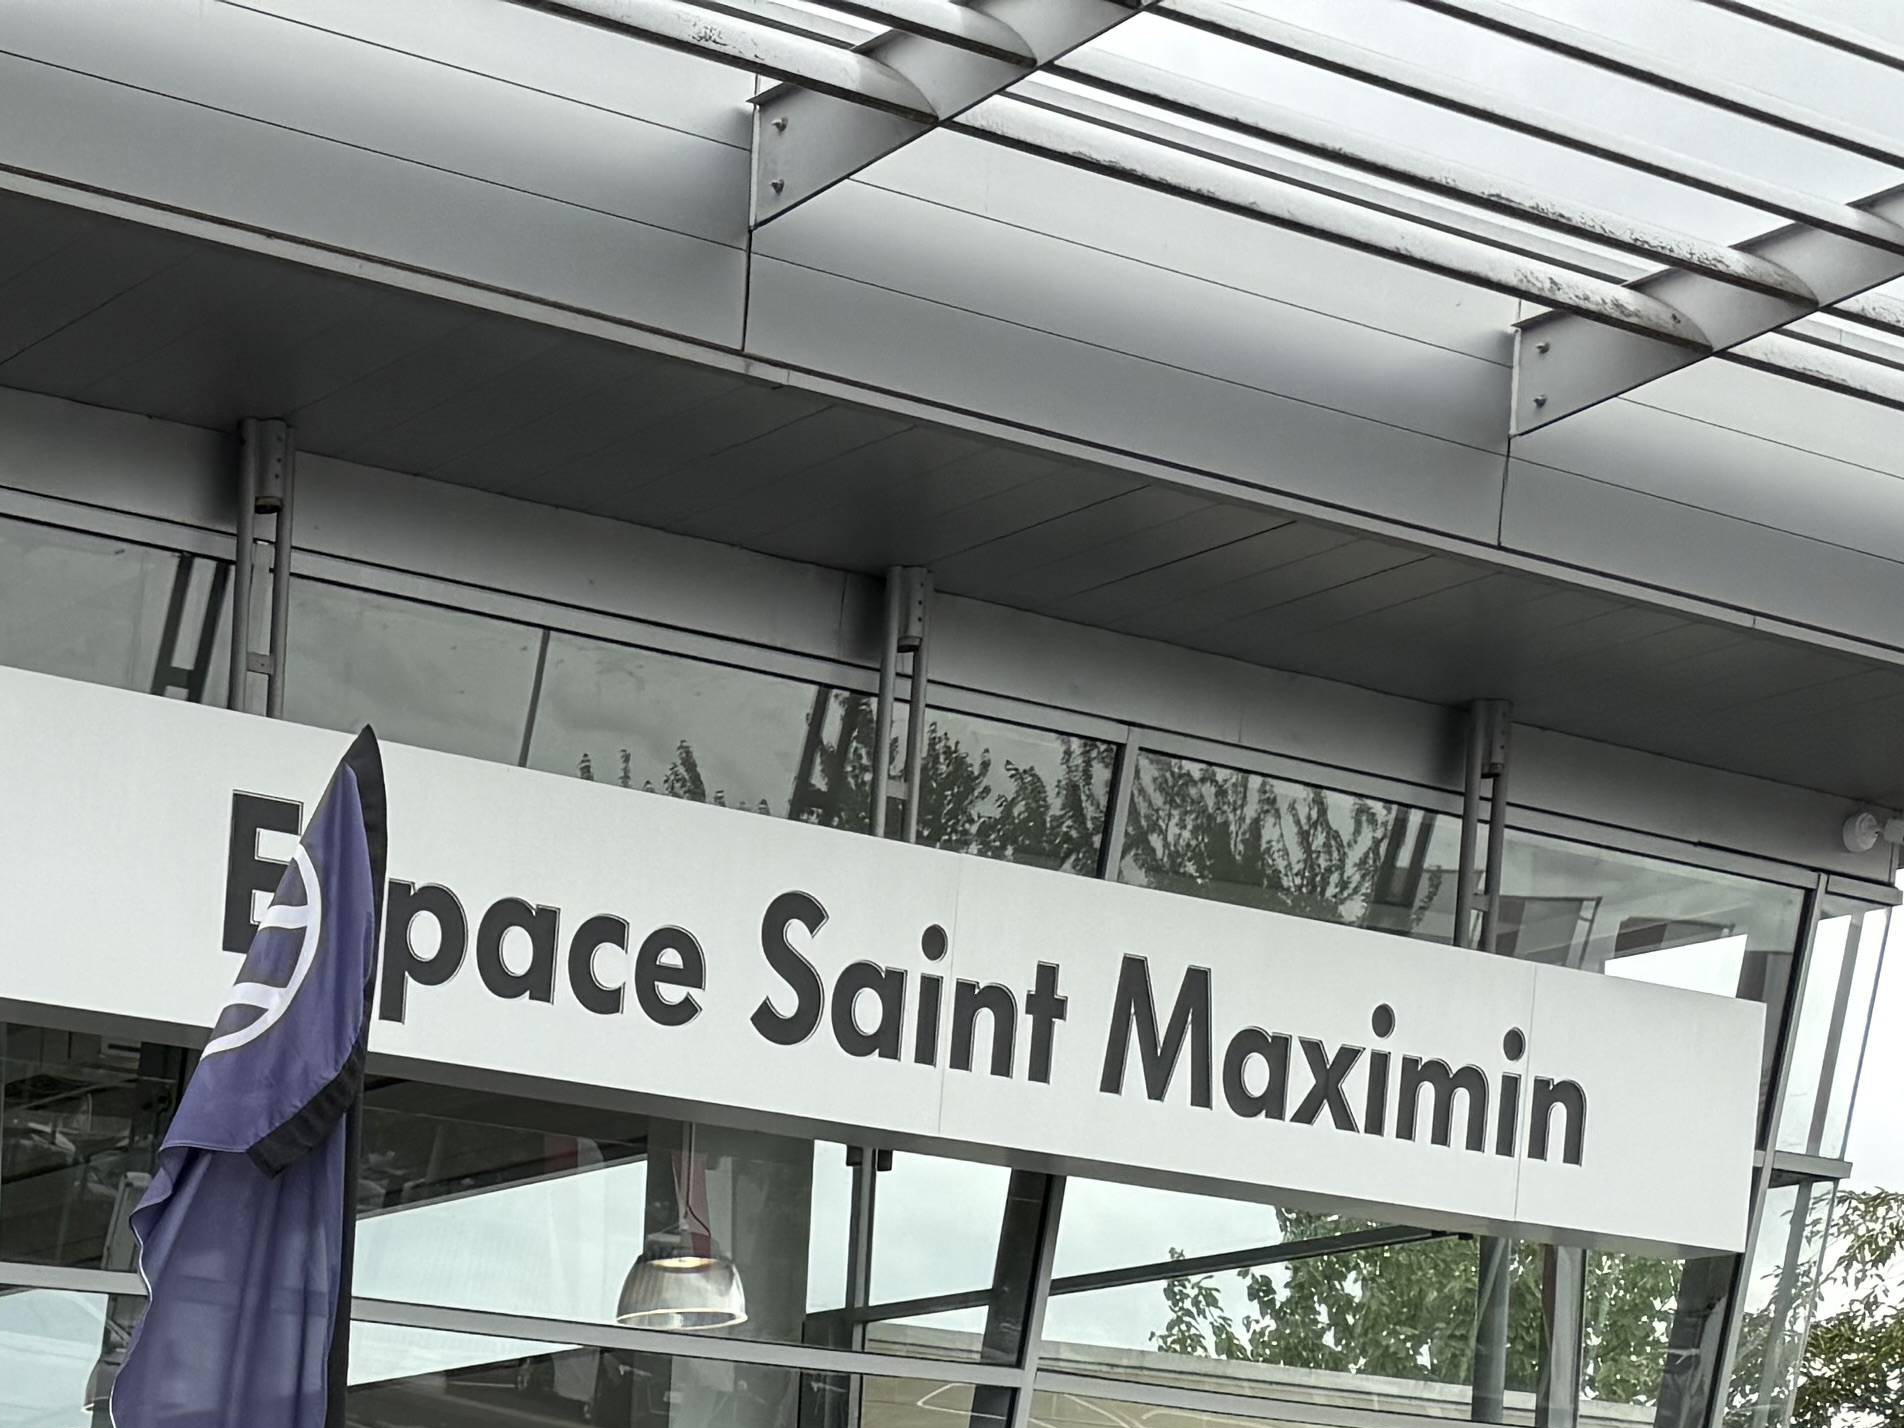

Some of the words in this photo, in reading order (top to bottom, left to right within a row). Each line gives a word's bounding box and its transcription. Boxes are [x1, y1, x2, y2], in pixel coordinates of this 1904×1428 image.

[222, 789, 706, 1026] Epace
[749, 890, 1068, 1086] Saint
[1100, 953, 1587, 1166] Maximin
